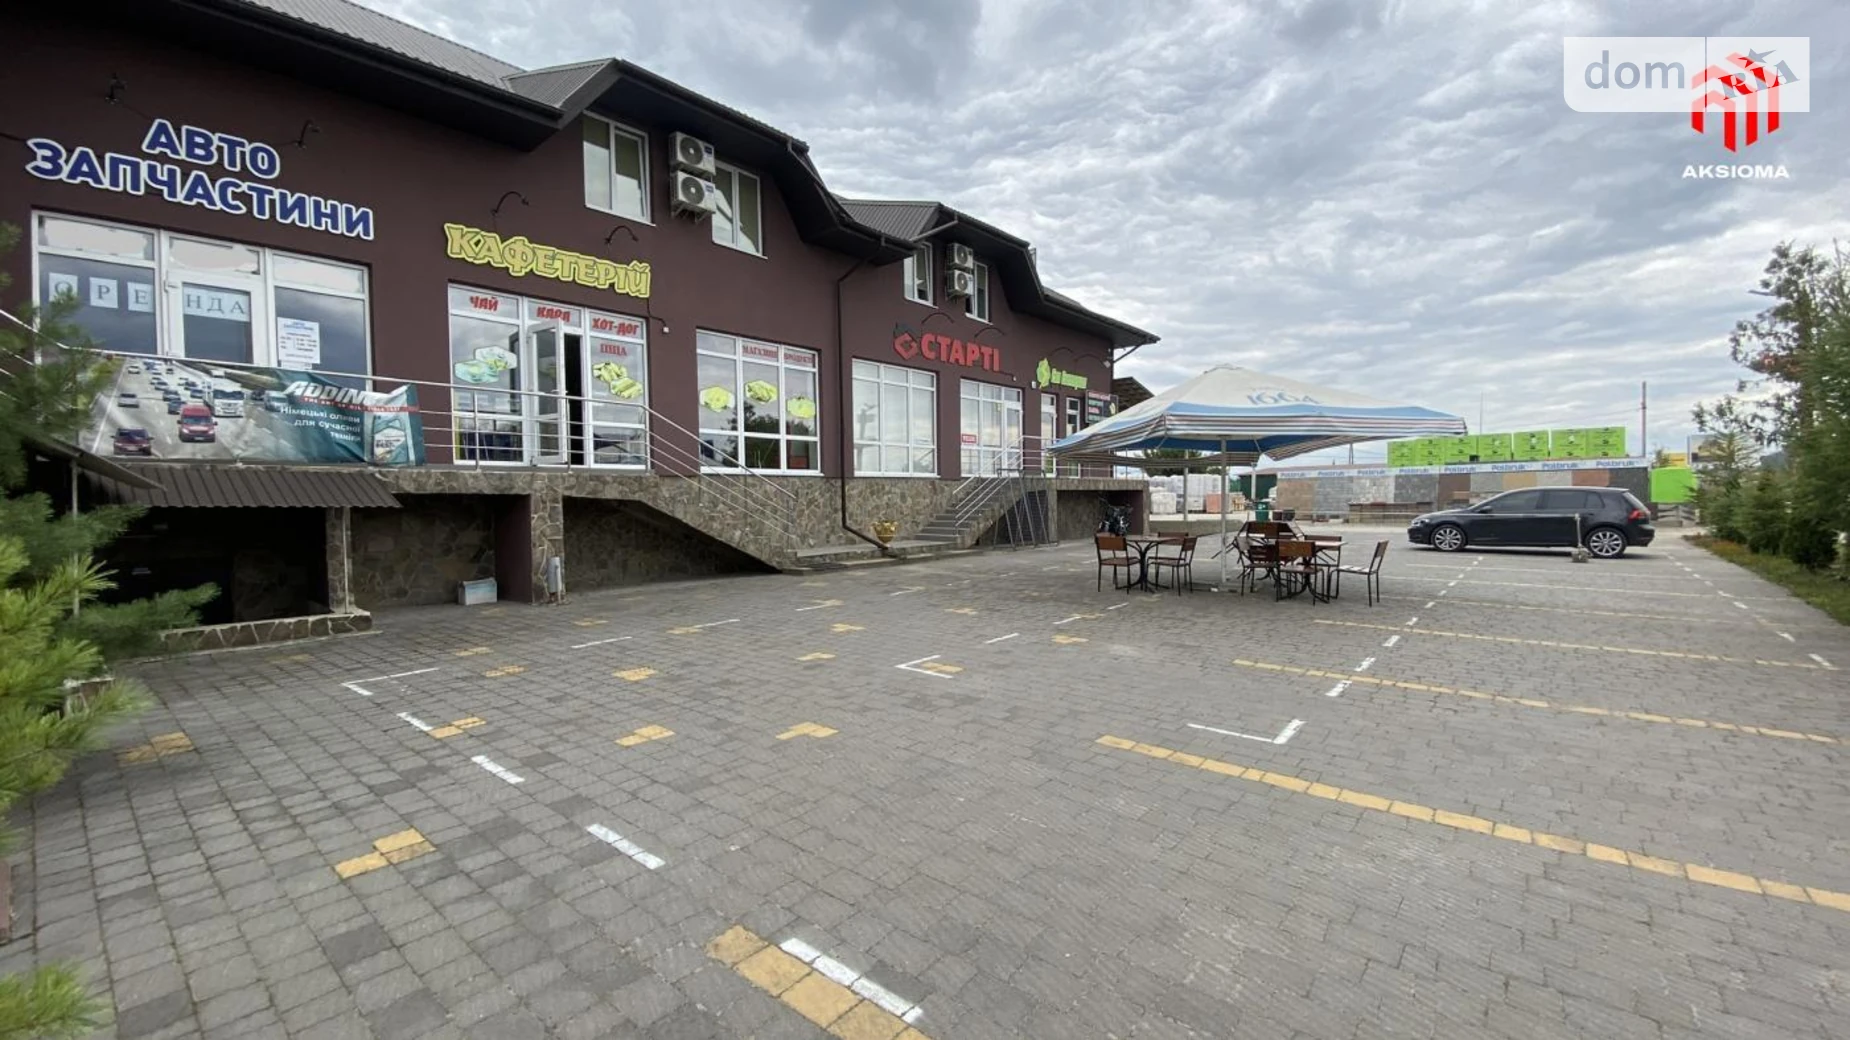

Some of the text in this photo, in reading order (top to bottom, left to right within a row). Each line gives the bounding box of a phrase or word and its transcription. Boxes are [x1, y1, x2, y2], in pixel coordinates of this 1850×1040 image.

[142, 118, 281, 179] АВТО
[25, 138, 375, 241] ЗАПЧАСТИНИ
[444, 222, 651, 298] КАФЕТЕРІЙ
[470, 295, 499, 312] ЧАЙ
[591, 317, 640, 336] ХОТ-ДОГ
[920, 332, 1000, 372] СТАРТІ
